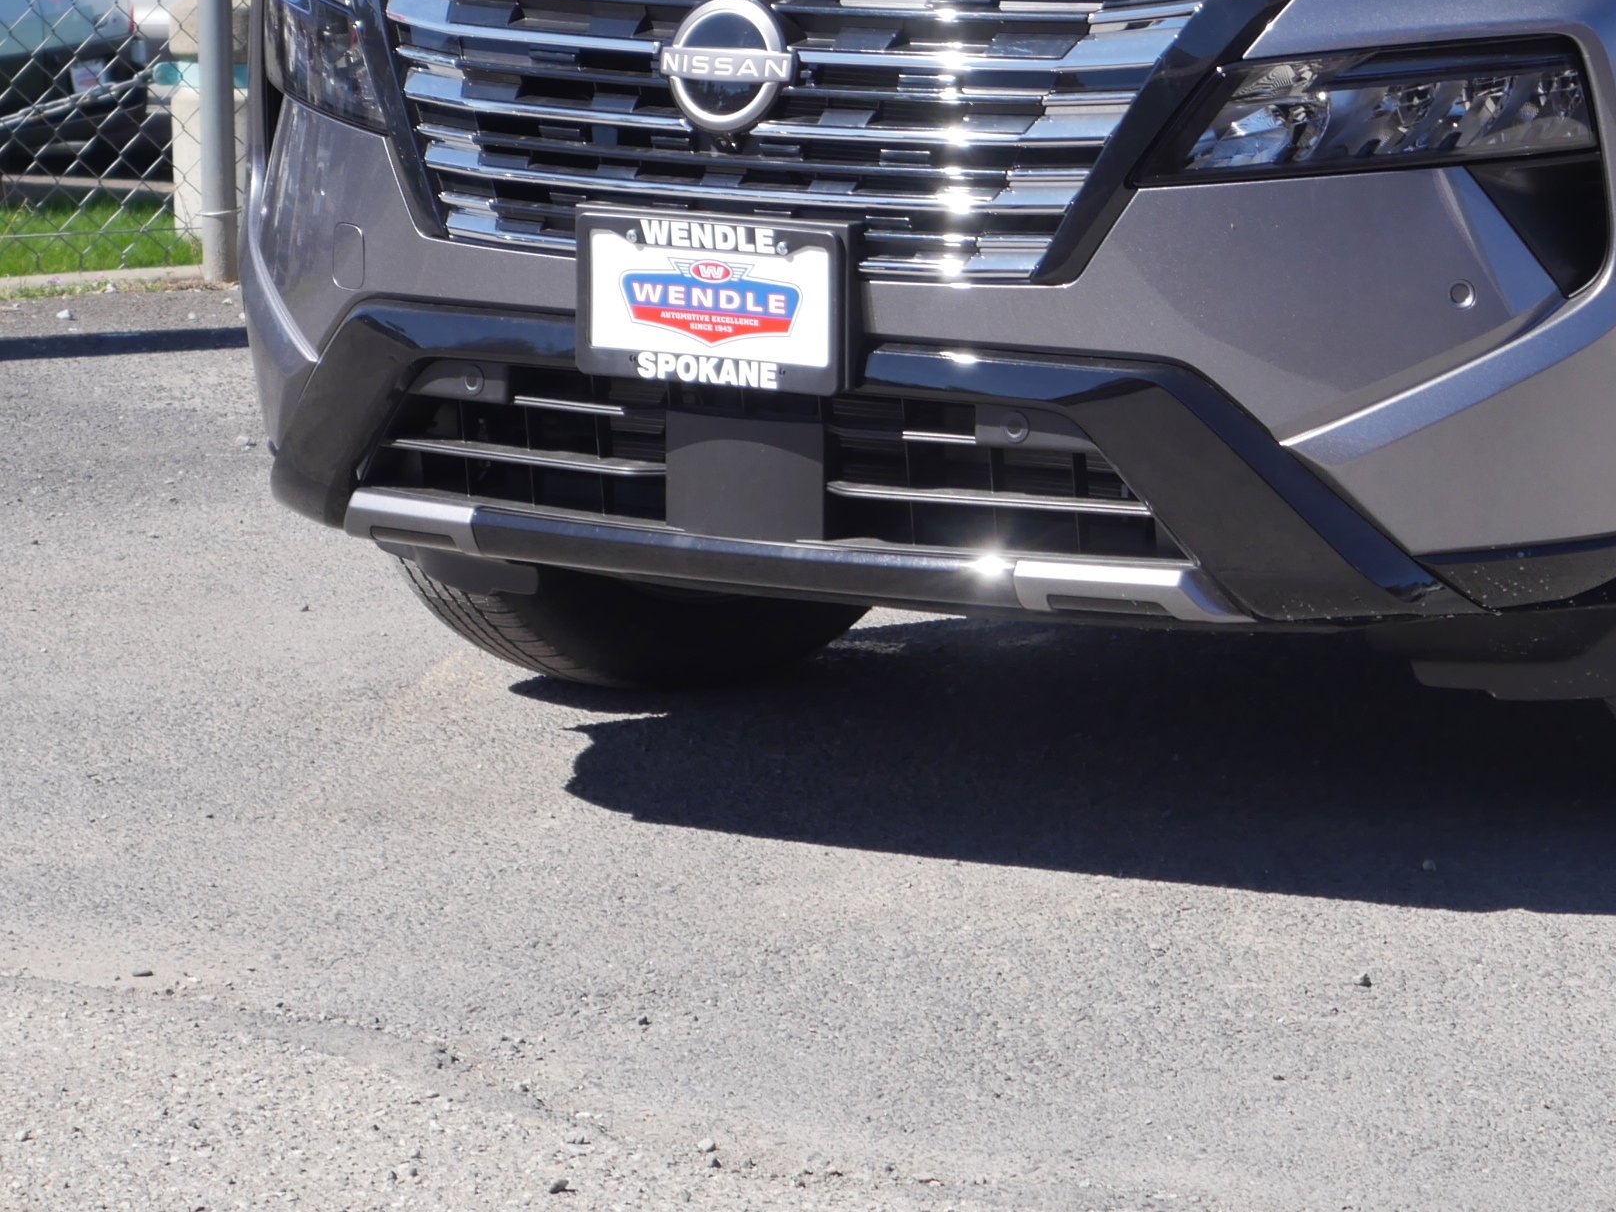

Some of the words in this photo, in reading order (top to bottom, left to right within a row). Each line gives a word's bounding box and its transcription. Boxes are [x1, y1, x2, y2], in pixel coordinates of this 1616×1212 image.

[662, 52, 788, 78] NISSAN
[639, 218, 777, 255] WENDLE
[631, 281, 787, 315] WENDLE
[659, 310, 710, 322] AUTOMOTIVE
[711, 315, 760, 327] EXCELLENCE
[689, 322, 713, 331] SINCE
[636, 351, 779, 389] SPOKANE
